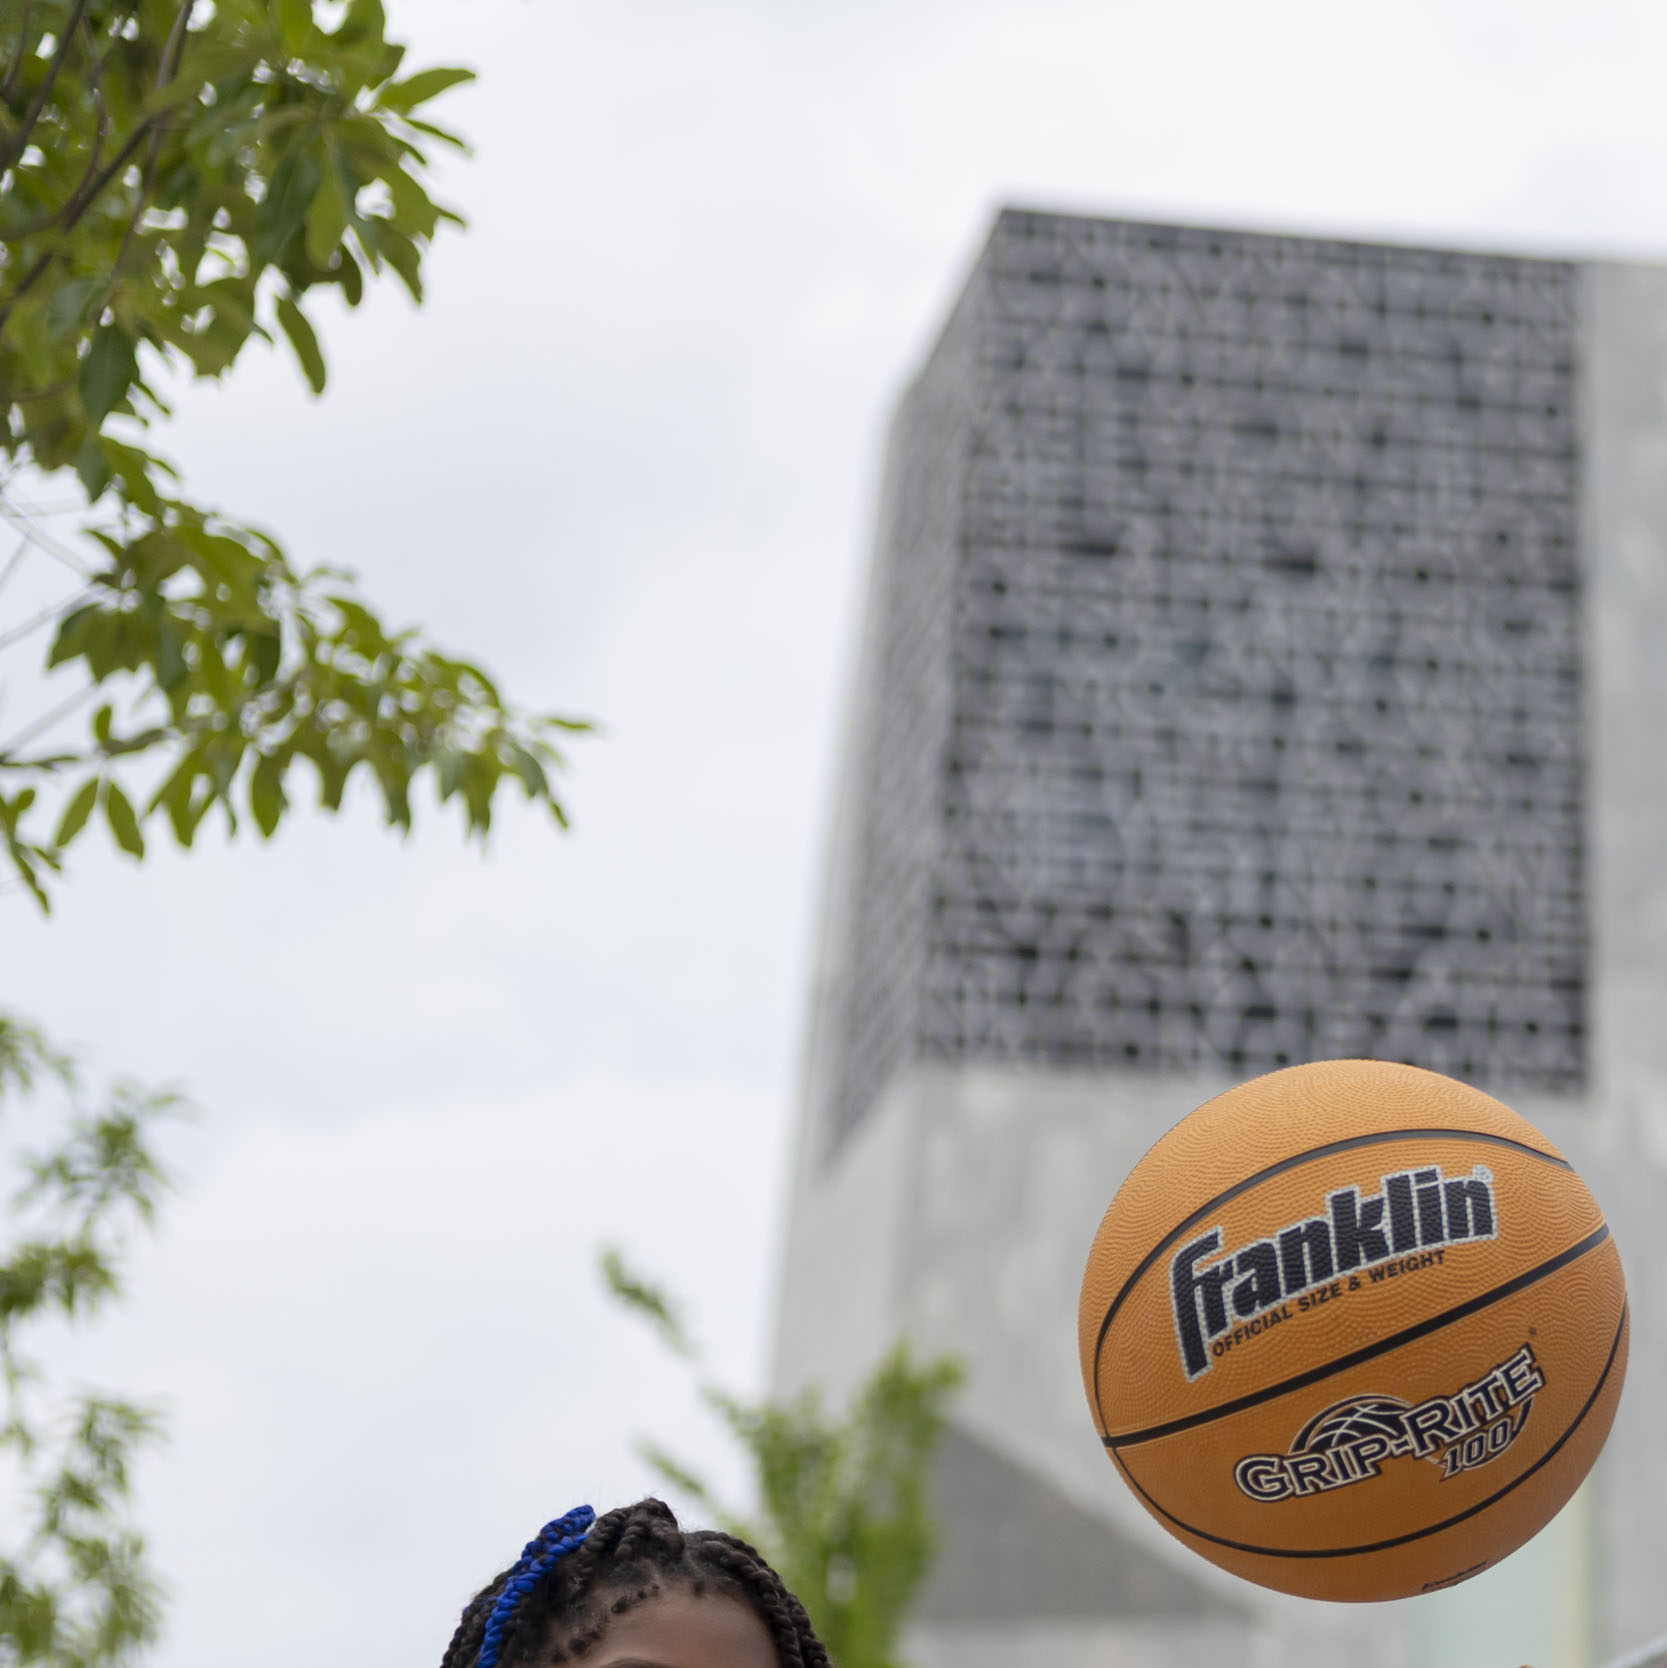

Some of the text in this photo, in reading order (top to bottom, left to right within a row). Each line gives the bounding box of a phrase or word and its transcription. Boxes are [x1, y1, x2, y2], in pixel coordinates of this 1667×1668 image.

[1211, 1250, 1447, 1358] OFFICIAL SIZE & WEIGHT
[1438, 1415, 1515, 1482] 100
